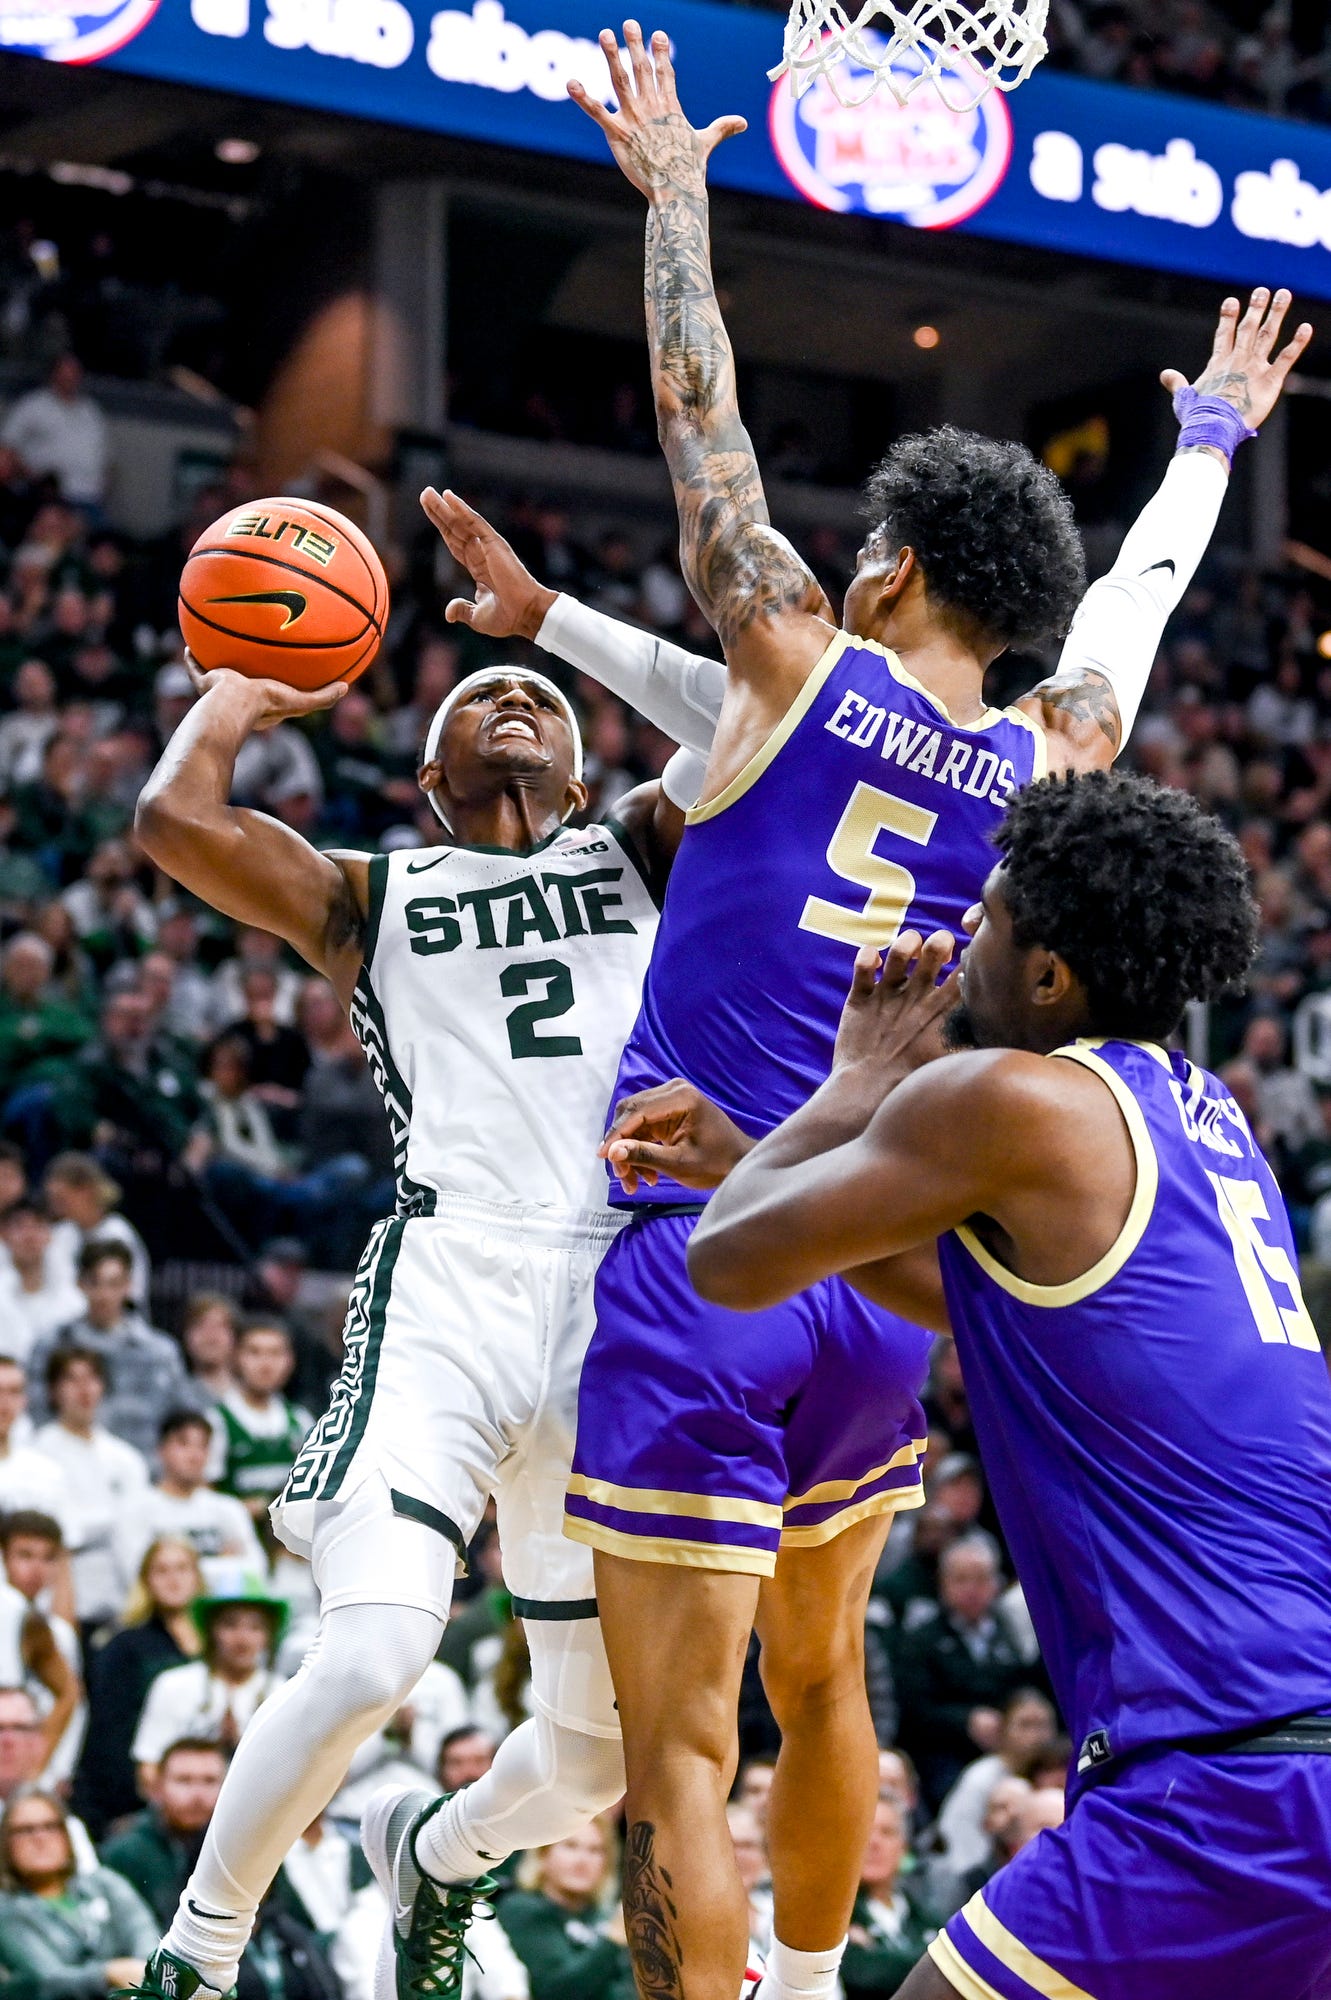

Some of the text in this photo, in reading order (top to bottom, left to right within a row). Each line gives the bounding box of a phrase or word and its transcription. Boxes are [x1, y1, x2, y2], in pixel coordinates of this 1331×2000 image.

[1030, 131, 1083, 202] a
[1093, 138, 1224, 228] sub
[225, 510, 338, 568] ELITE
[824, 689, 1016, 808] EDWARDS
[404, 867, 638, 956] STATE
[798, 779, 939, 951] 5
[499, 958, 583, 1059] 2
[1204, 1168, 1321, 1353] 15
[1089, 1740, 1105, 1757] XL
